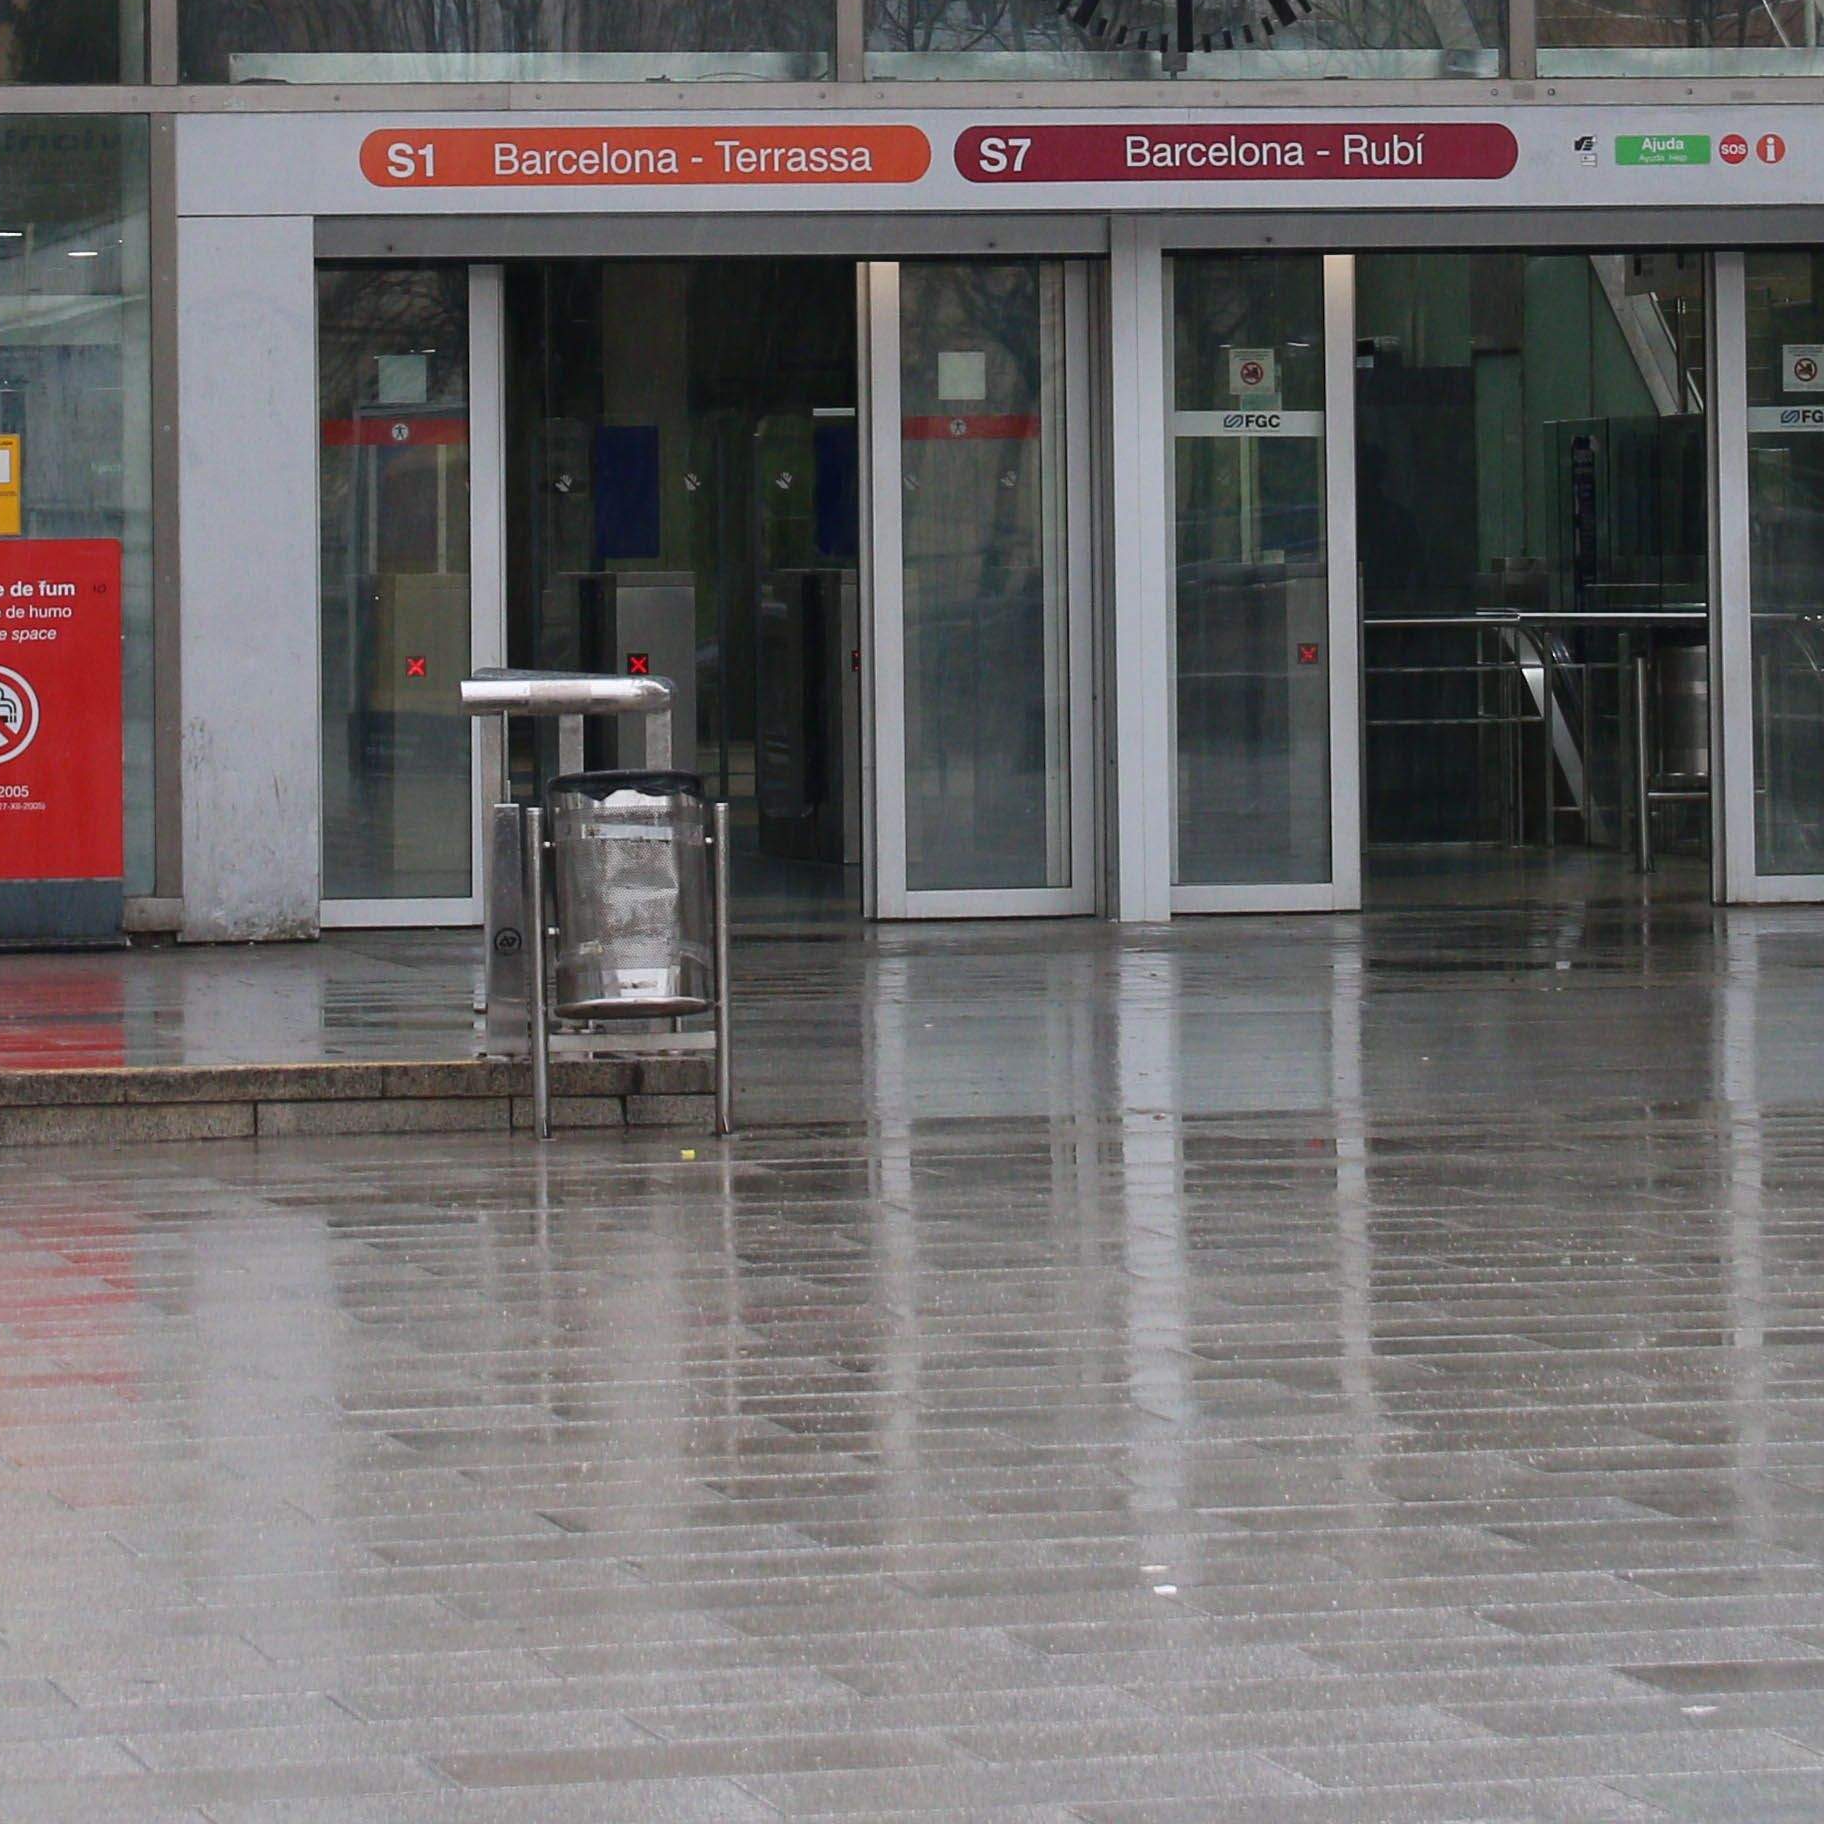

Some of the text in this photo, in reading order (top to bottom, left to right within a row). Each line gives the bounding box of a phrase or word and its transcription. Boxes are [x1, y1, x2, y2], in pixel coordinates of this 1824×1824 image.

[977, 137, 1032, 173] S7
[1125, 136, 1305, 169] Barcelona
[1342, 133, 1424, 167] Rubí
[1641, 137, 1685, 154] Ajuda
[1721, 144, 1747, 155] SOS
[386, 143, 435, 179] S1
[494, 142, 679, 176] Barcelona
[714, 140, 873, 174] Terrassa
[1245, 414, 1281, 429] FGC
[10, 581, 34, 597] de
[38, 579, 75, 596] fum
[5, 605, 25, 619] de
[29, 605, 72, 618] humo
[11, 629, 57, 644] space
